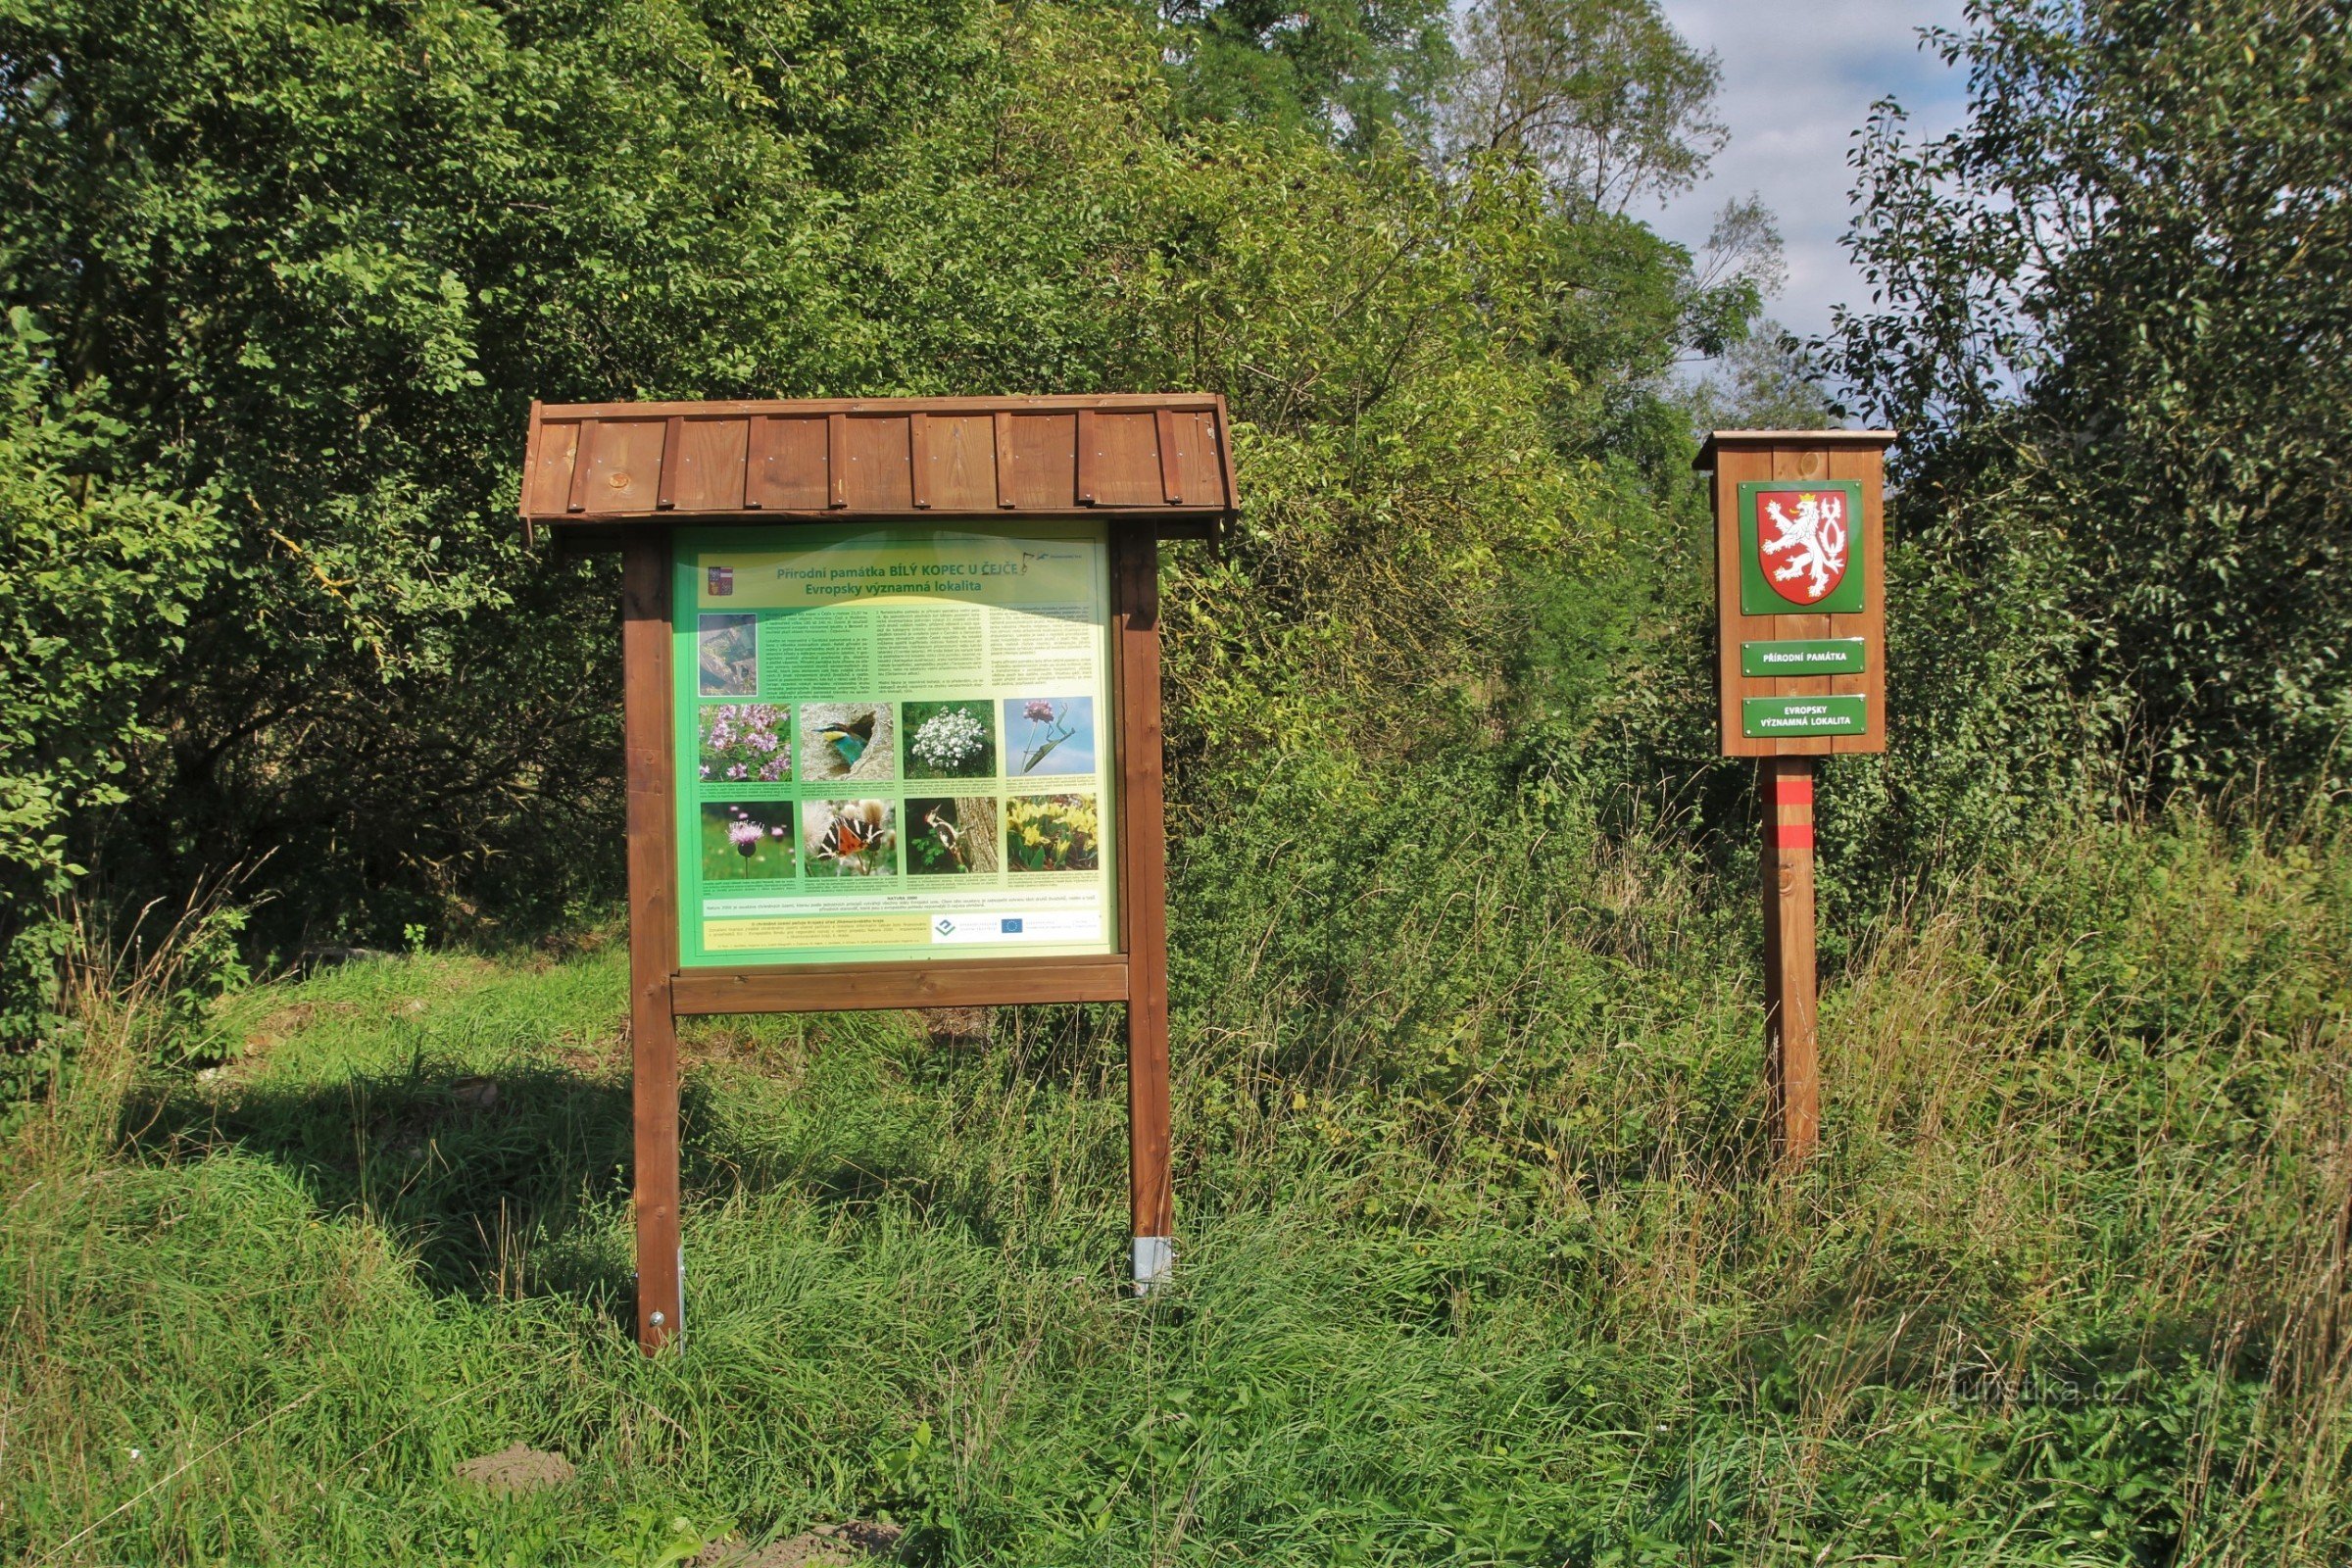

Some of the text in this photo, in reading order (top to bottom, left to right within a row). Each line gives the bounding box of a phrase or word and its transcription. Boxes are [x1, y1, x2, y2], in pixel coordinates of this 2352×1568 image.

[777, 563, 1018, 580] Přírodní památka BÍLÝ KOPEC U ČEJČE
[806, 580, 982, 597] Evropsky významná lokalita
[1763, 651, 1847, 662] PŘÍRODNÍ PAMÁTKA
[1784, 706, 1828, 715] EVROPSKY
[1760, 716, 1851, 727] VÝZNAMNÁ LOKALITA
